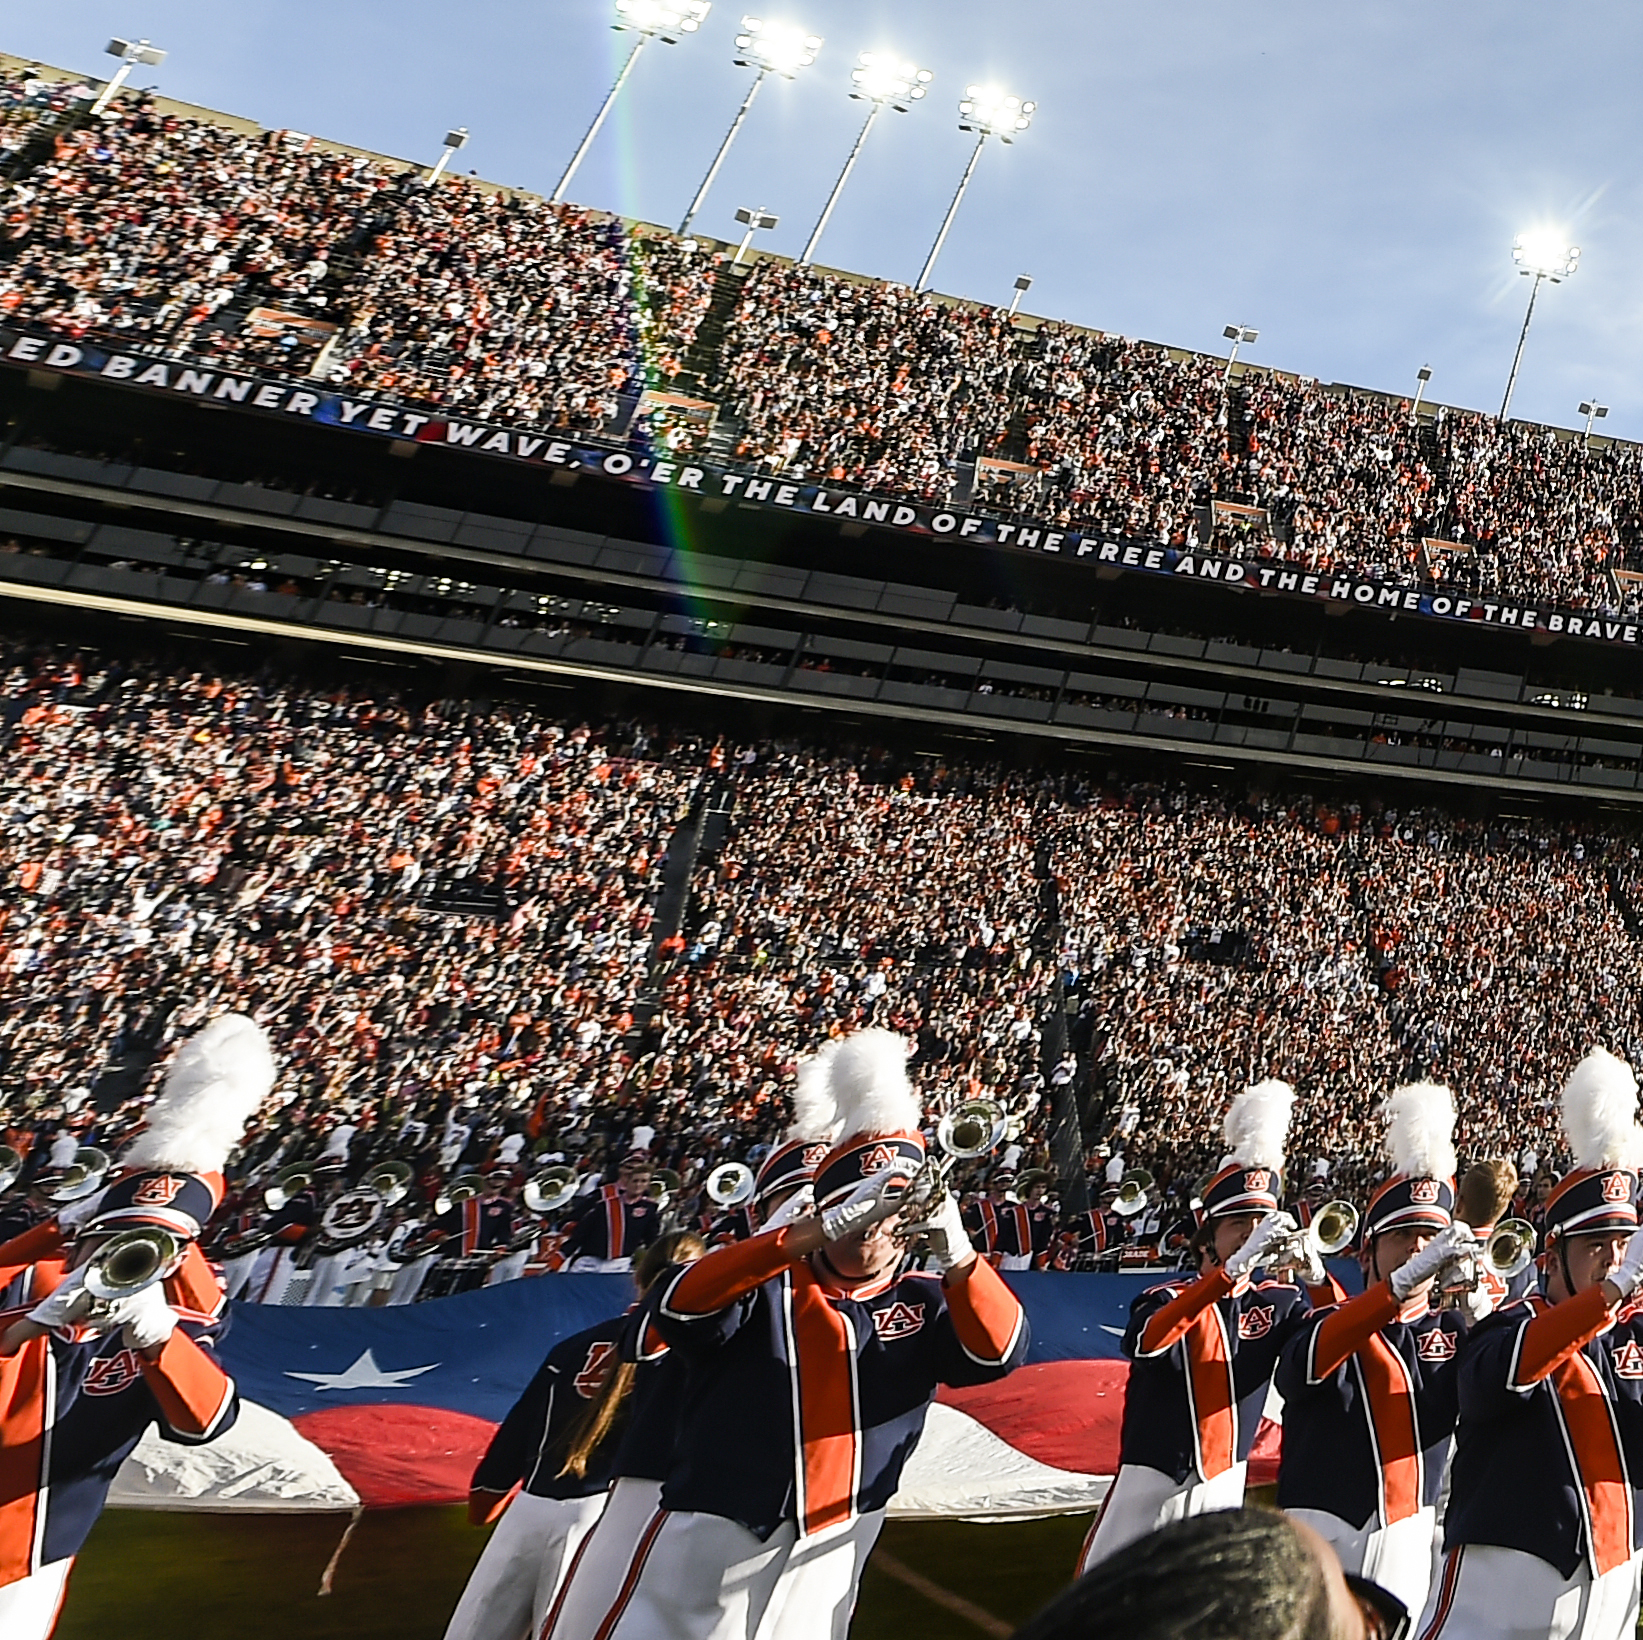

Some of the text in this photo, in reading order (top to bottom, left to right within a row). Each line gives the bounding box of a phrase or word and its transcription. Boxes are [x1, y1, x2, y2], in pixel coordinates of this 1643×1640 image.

[100, 355, 320, 416] BANNER
[340, 401, 430, 436] YET
[446, 422, 582, 469] WAVE,
[602, 453, 705, 489] O'ER
[721, 473, 799, 506] THE
[811, 491, 917, 526] LAND
[930, 513, 982, 537] OF
[996, 523, 1065, 552] THE
[1076, 538, 1164, 569] FREE
[1175, 556, 1244, 582] AND
[1259, 568, 1319, 594] THE
[1331, 580, 1421, 610] HOME
[1431, 596, 1472, 617] OF
[1483, 603, 1538, 628] THE
